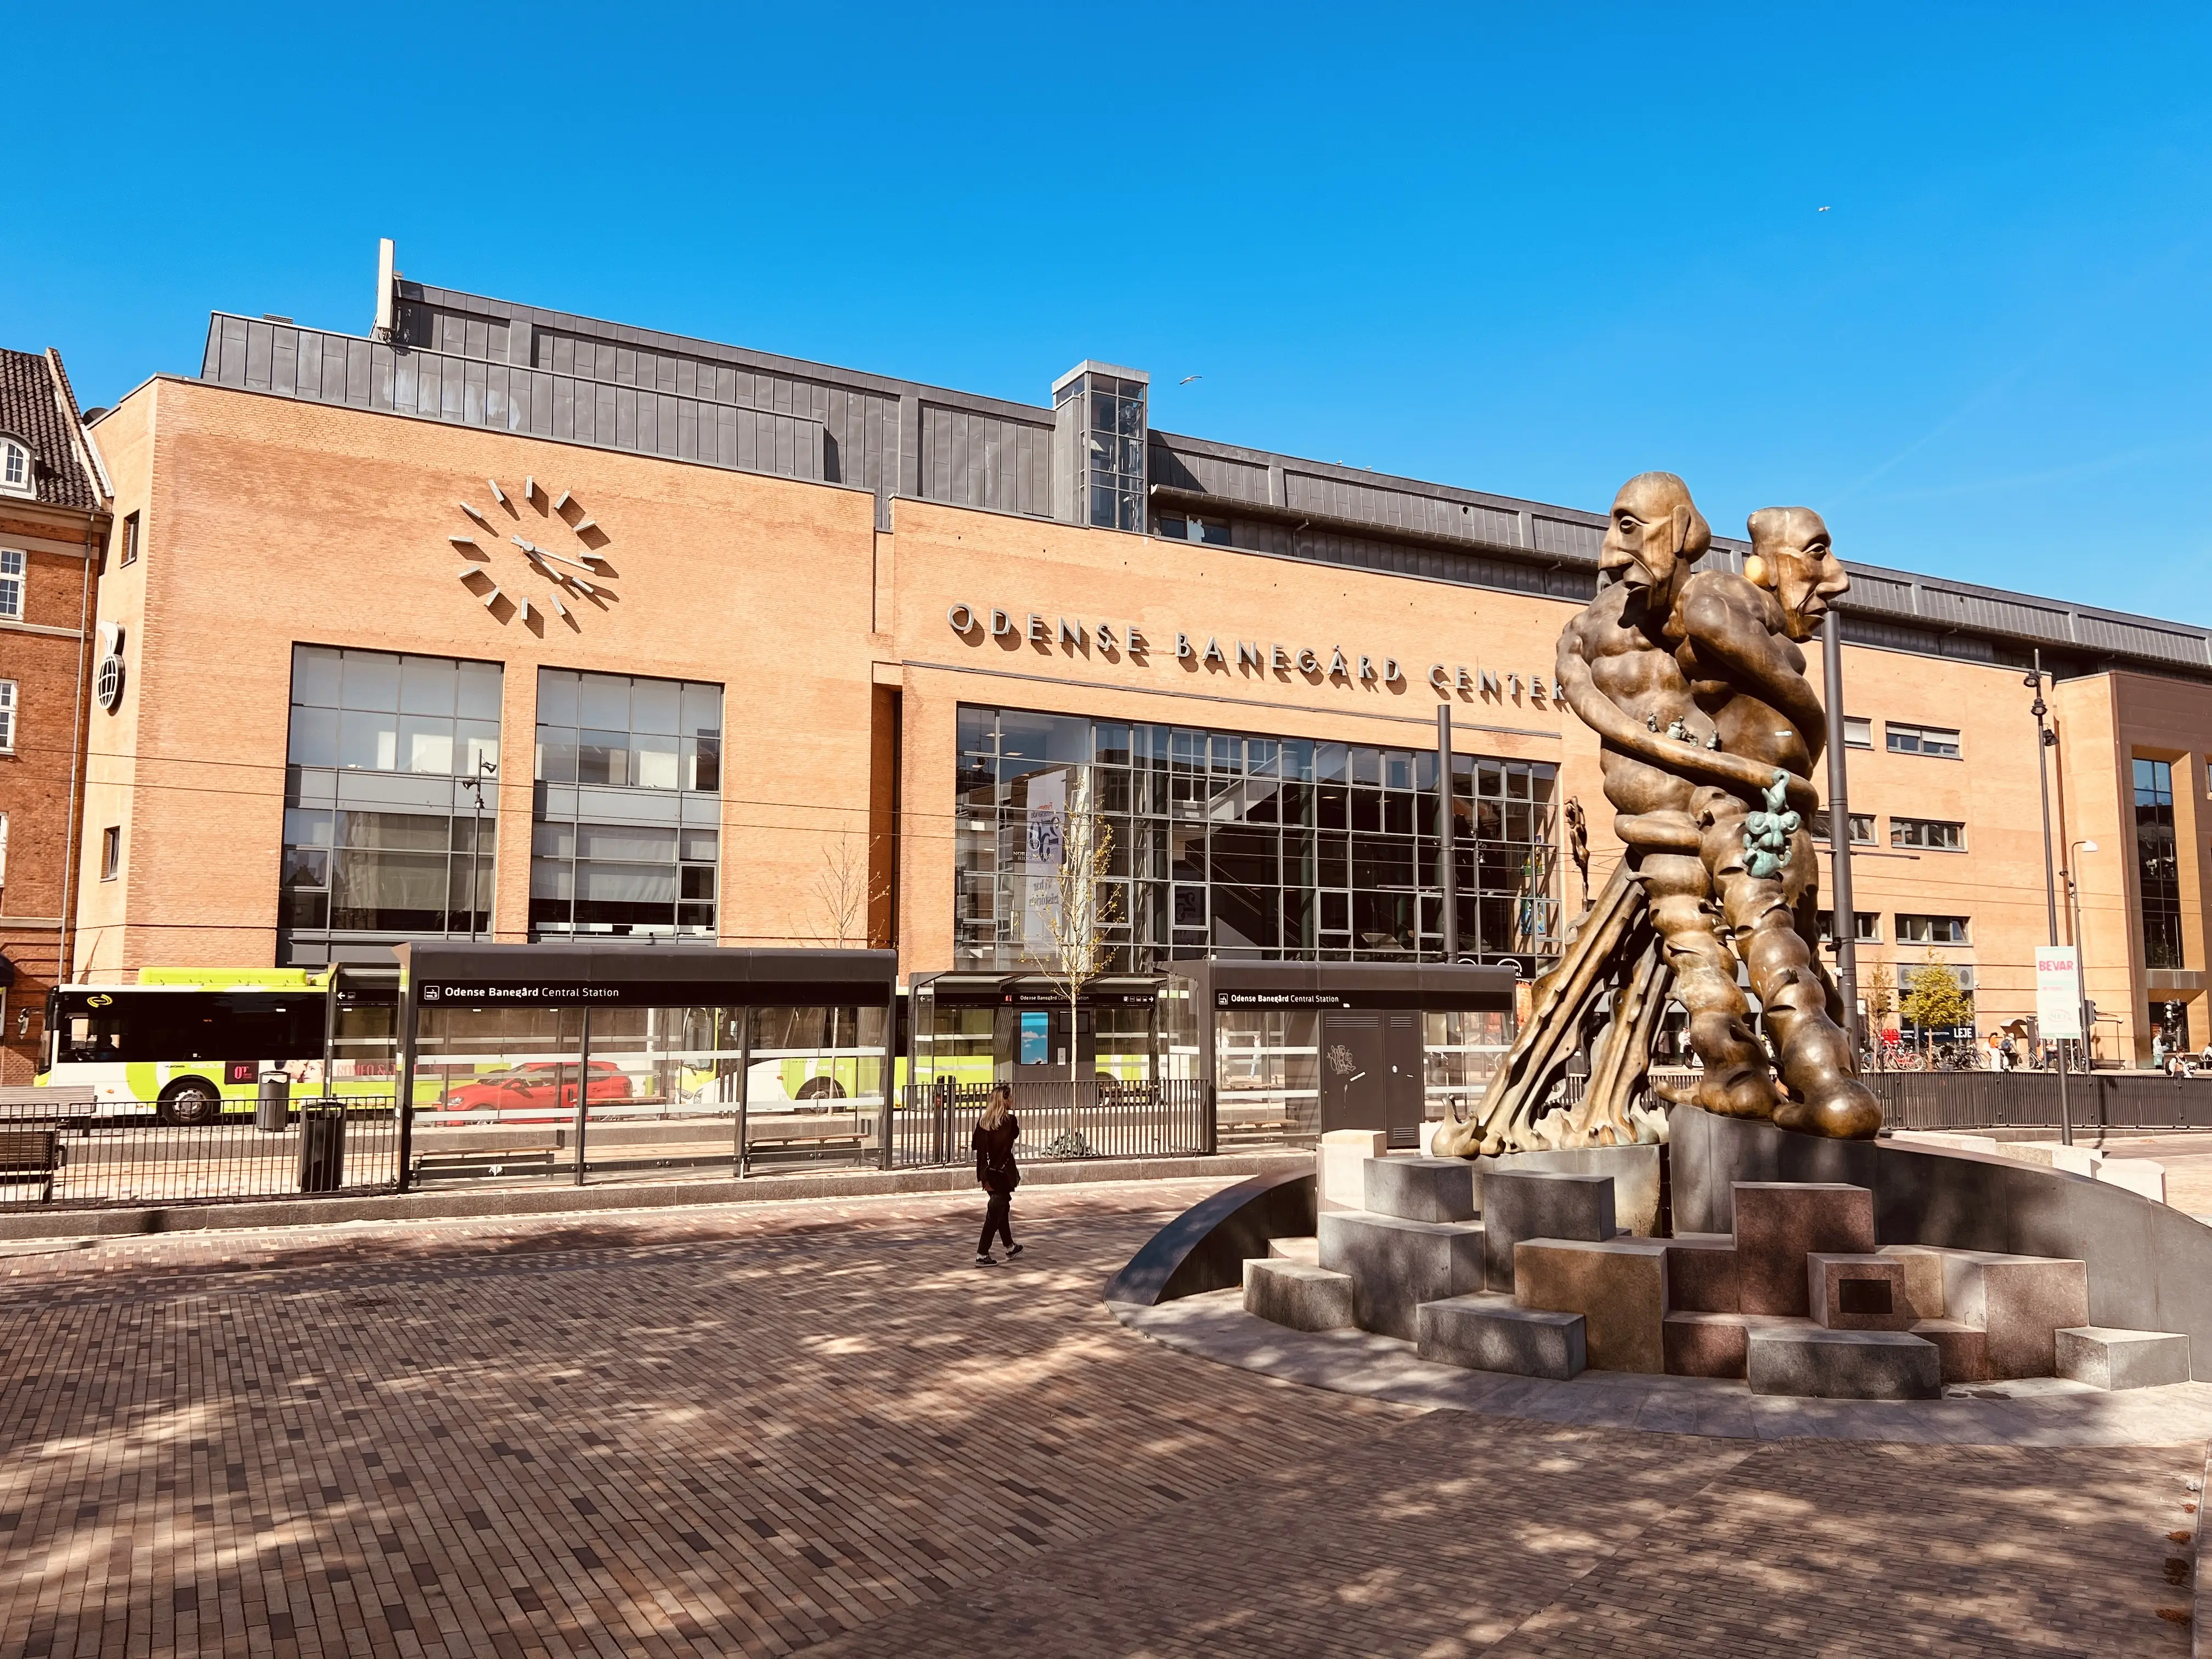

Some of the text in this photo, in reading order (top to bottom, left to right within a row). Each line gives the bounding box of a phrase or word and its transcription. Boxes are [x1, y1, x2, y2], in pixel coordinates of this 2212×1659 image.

[947, 603, 1566, 701] ODENSE BANEGÅRD CENTER
[2039, 961, 2074, 971] BEVAR
[445, 987, 619, 998] Odense Banegård Central Station
[1231, 994, 1339, 1003] Odense Banegård Central Station
[1953, 1028, 1973, 1038] LEJE
[337, 1064, 375, 1076] ROMEO
